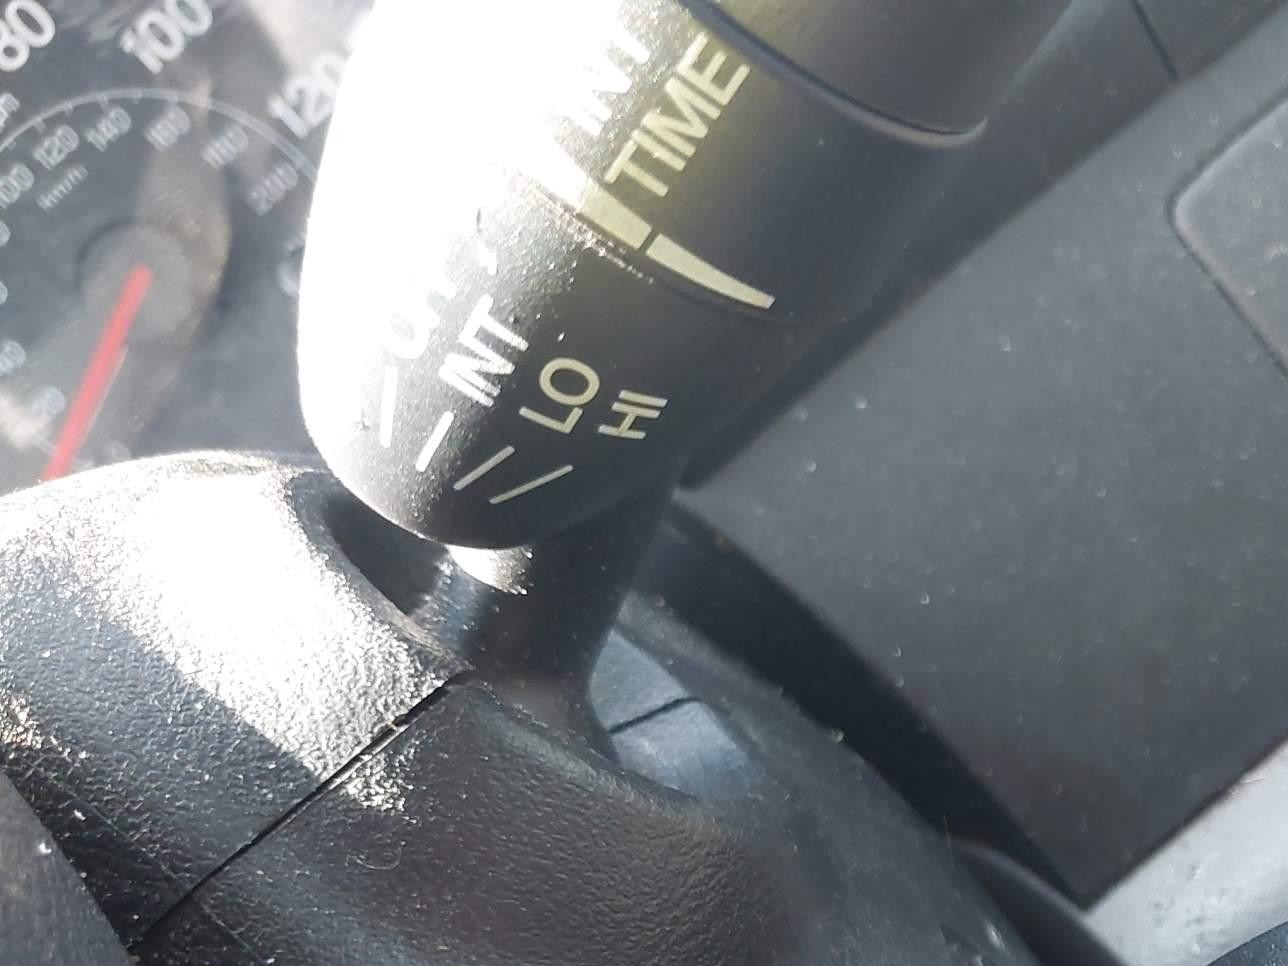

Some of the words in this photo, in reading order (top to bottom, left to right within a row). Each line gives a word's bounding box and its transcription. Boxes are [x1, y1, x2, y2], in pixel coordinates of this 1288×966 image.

[120, 0, 213, 74] 100
[604, 32, 750, 197] TIME
[438, 294, 529, 407] INT
[518, 357, 600, 434] LO
[598, 390, 668, 440] HI
